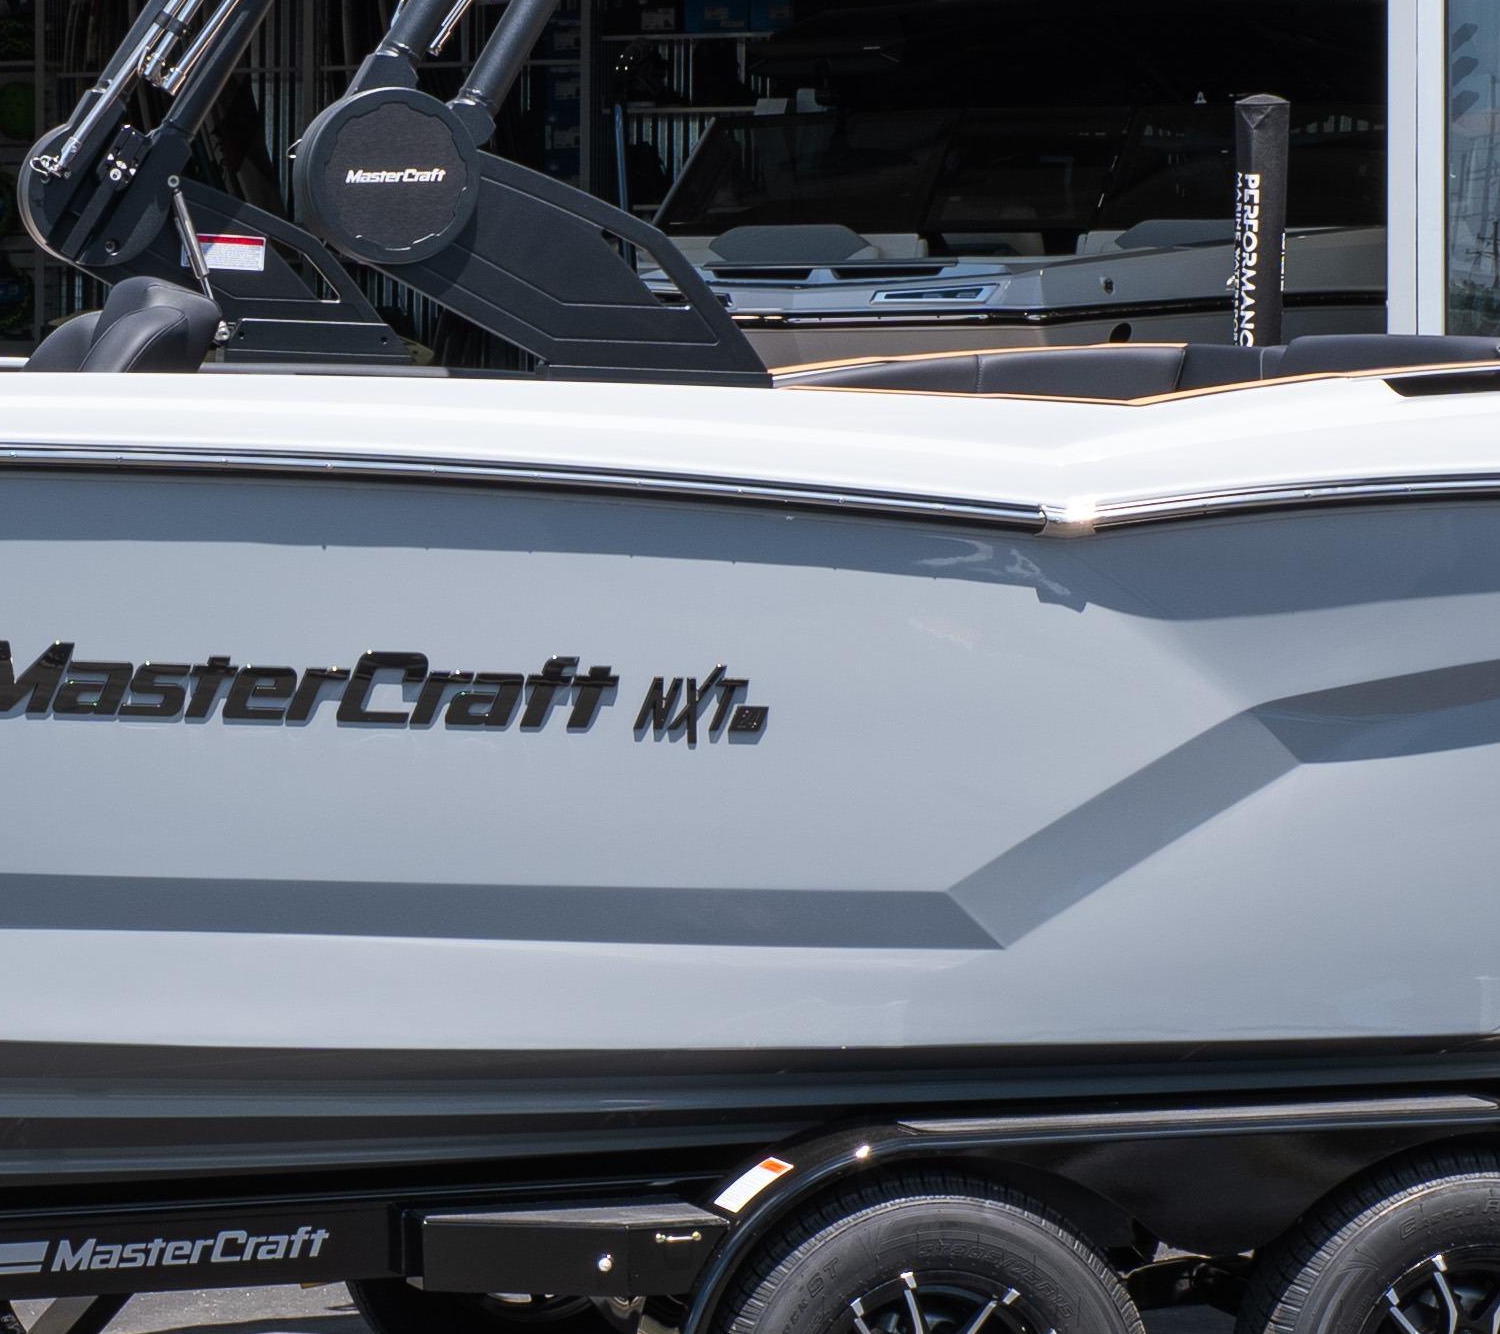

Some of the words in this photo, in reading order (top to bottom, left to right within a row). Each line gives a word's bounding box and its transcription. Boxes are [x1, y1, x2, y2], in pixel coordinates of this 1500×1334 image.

[345, 168, 446, 184] MasterCraft
[633, 662, 751, 748] NXT
[51, 1226, 330, 1272] MasterCraft
